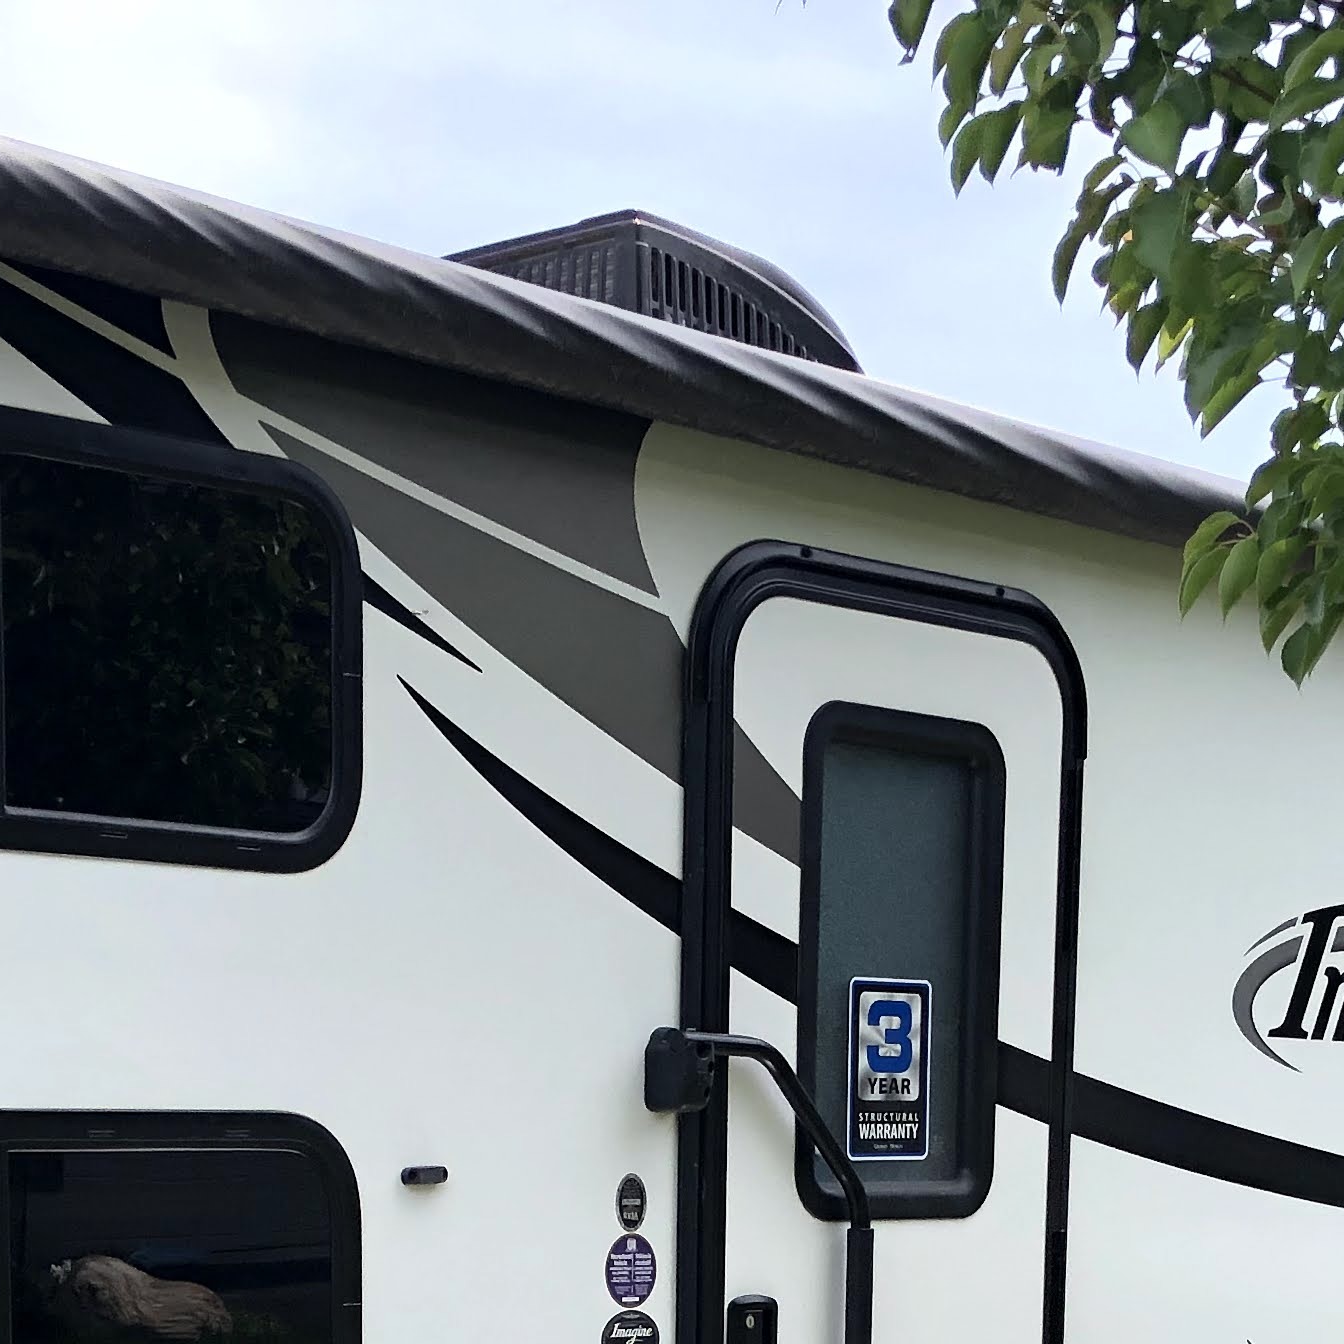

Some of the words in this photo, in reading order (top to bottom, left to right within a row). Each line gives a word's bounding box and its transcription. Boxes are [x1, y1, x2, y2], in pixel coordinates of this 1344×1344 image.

[867, 1000, 913, 1074] 3
[868, 1077, 911, 1095] YEAR
[858, 1112, 919, 1122] STRUCTURAL
[859, 1123, 919, 1140] WARRANTY
